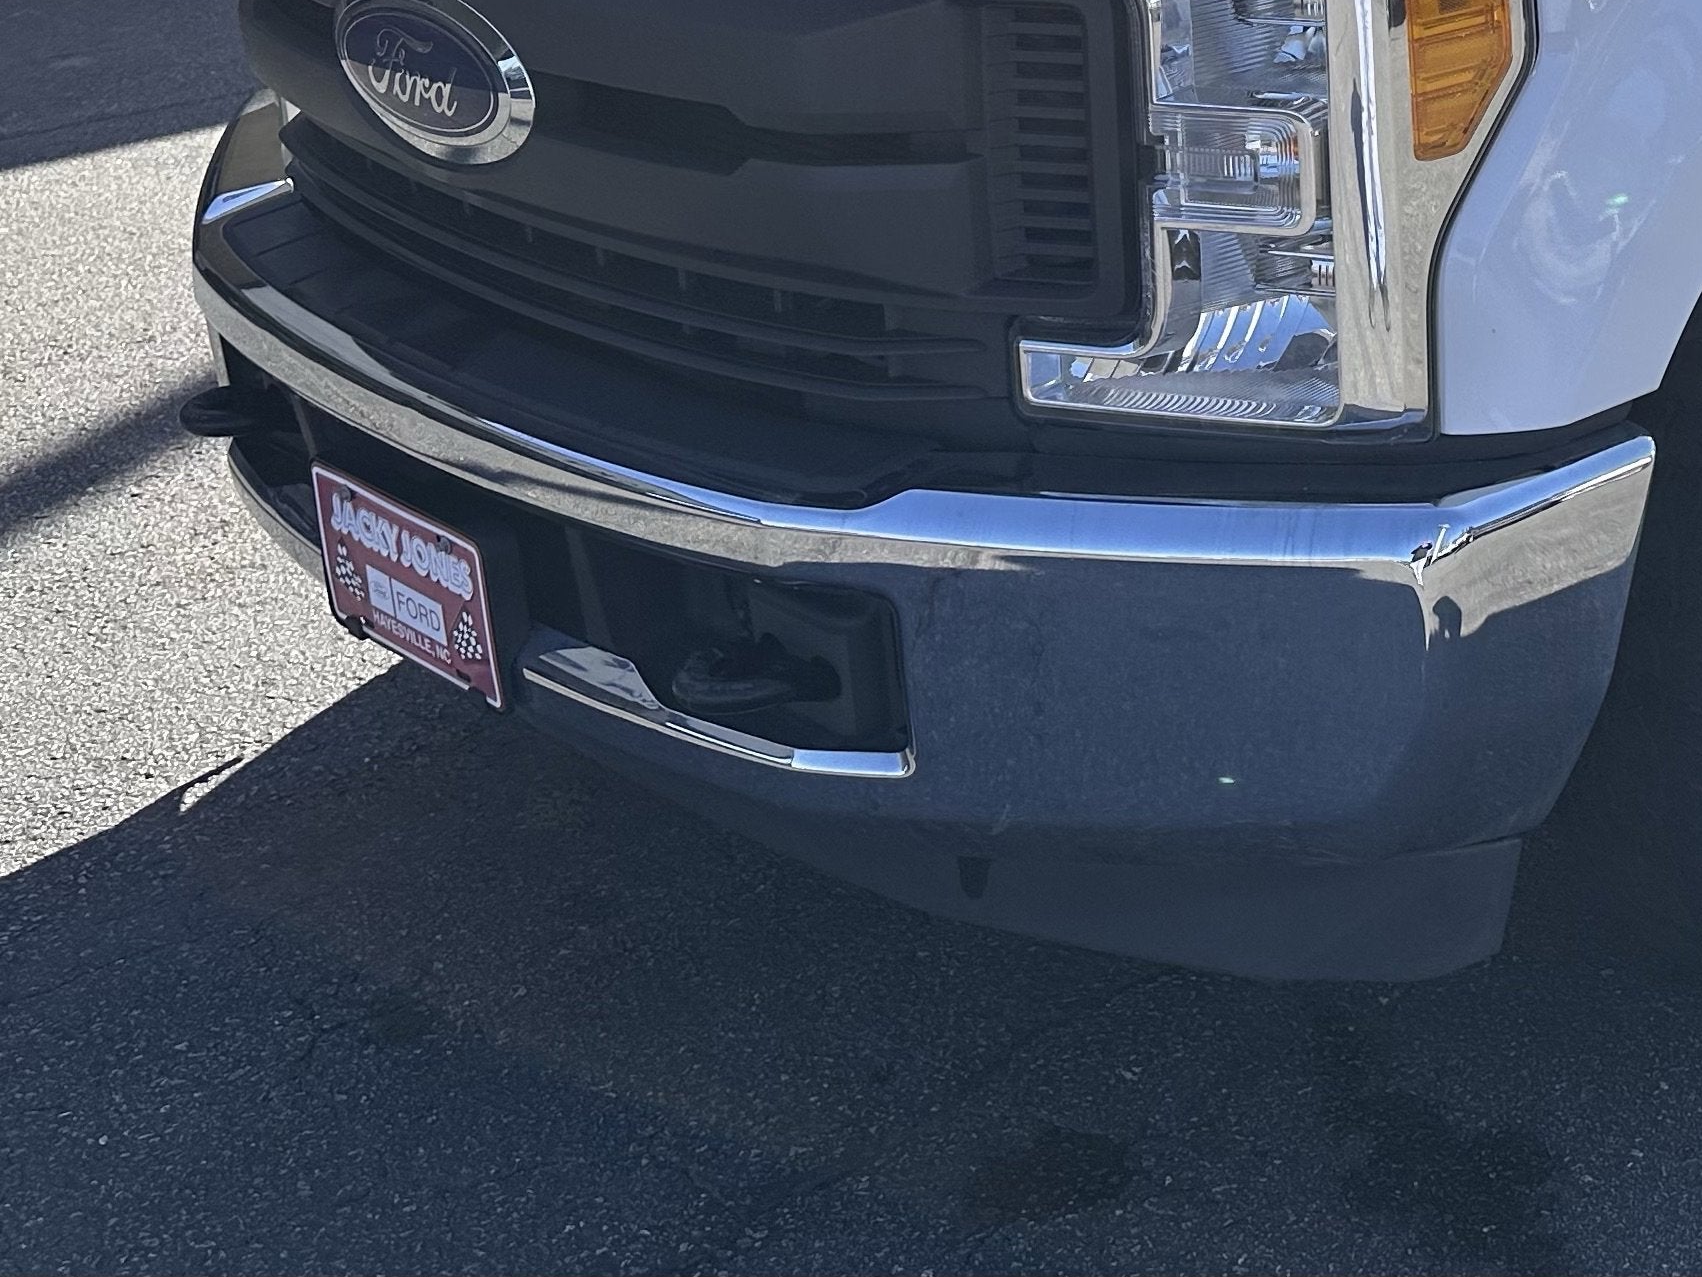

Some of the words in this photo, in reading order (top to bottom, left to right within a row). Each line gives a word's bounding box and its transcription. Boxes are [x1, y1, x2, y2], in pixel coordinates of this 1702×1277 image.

[368, 27, 458, 117] Ford
[331, 492, 400, 562] JACKY
[401, 529, 474, 601] JONES
[372, 609, 434, 658] HAYESVILLE,
[395, 590, 441, 632] FORD
